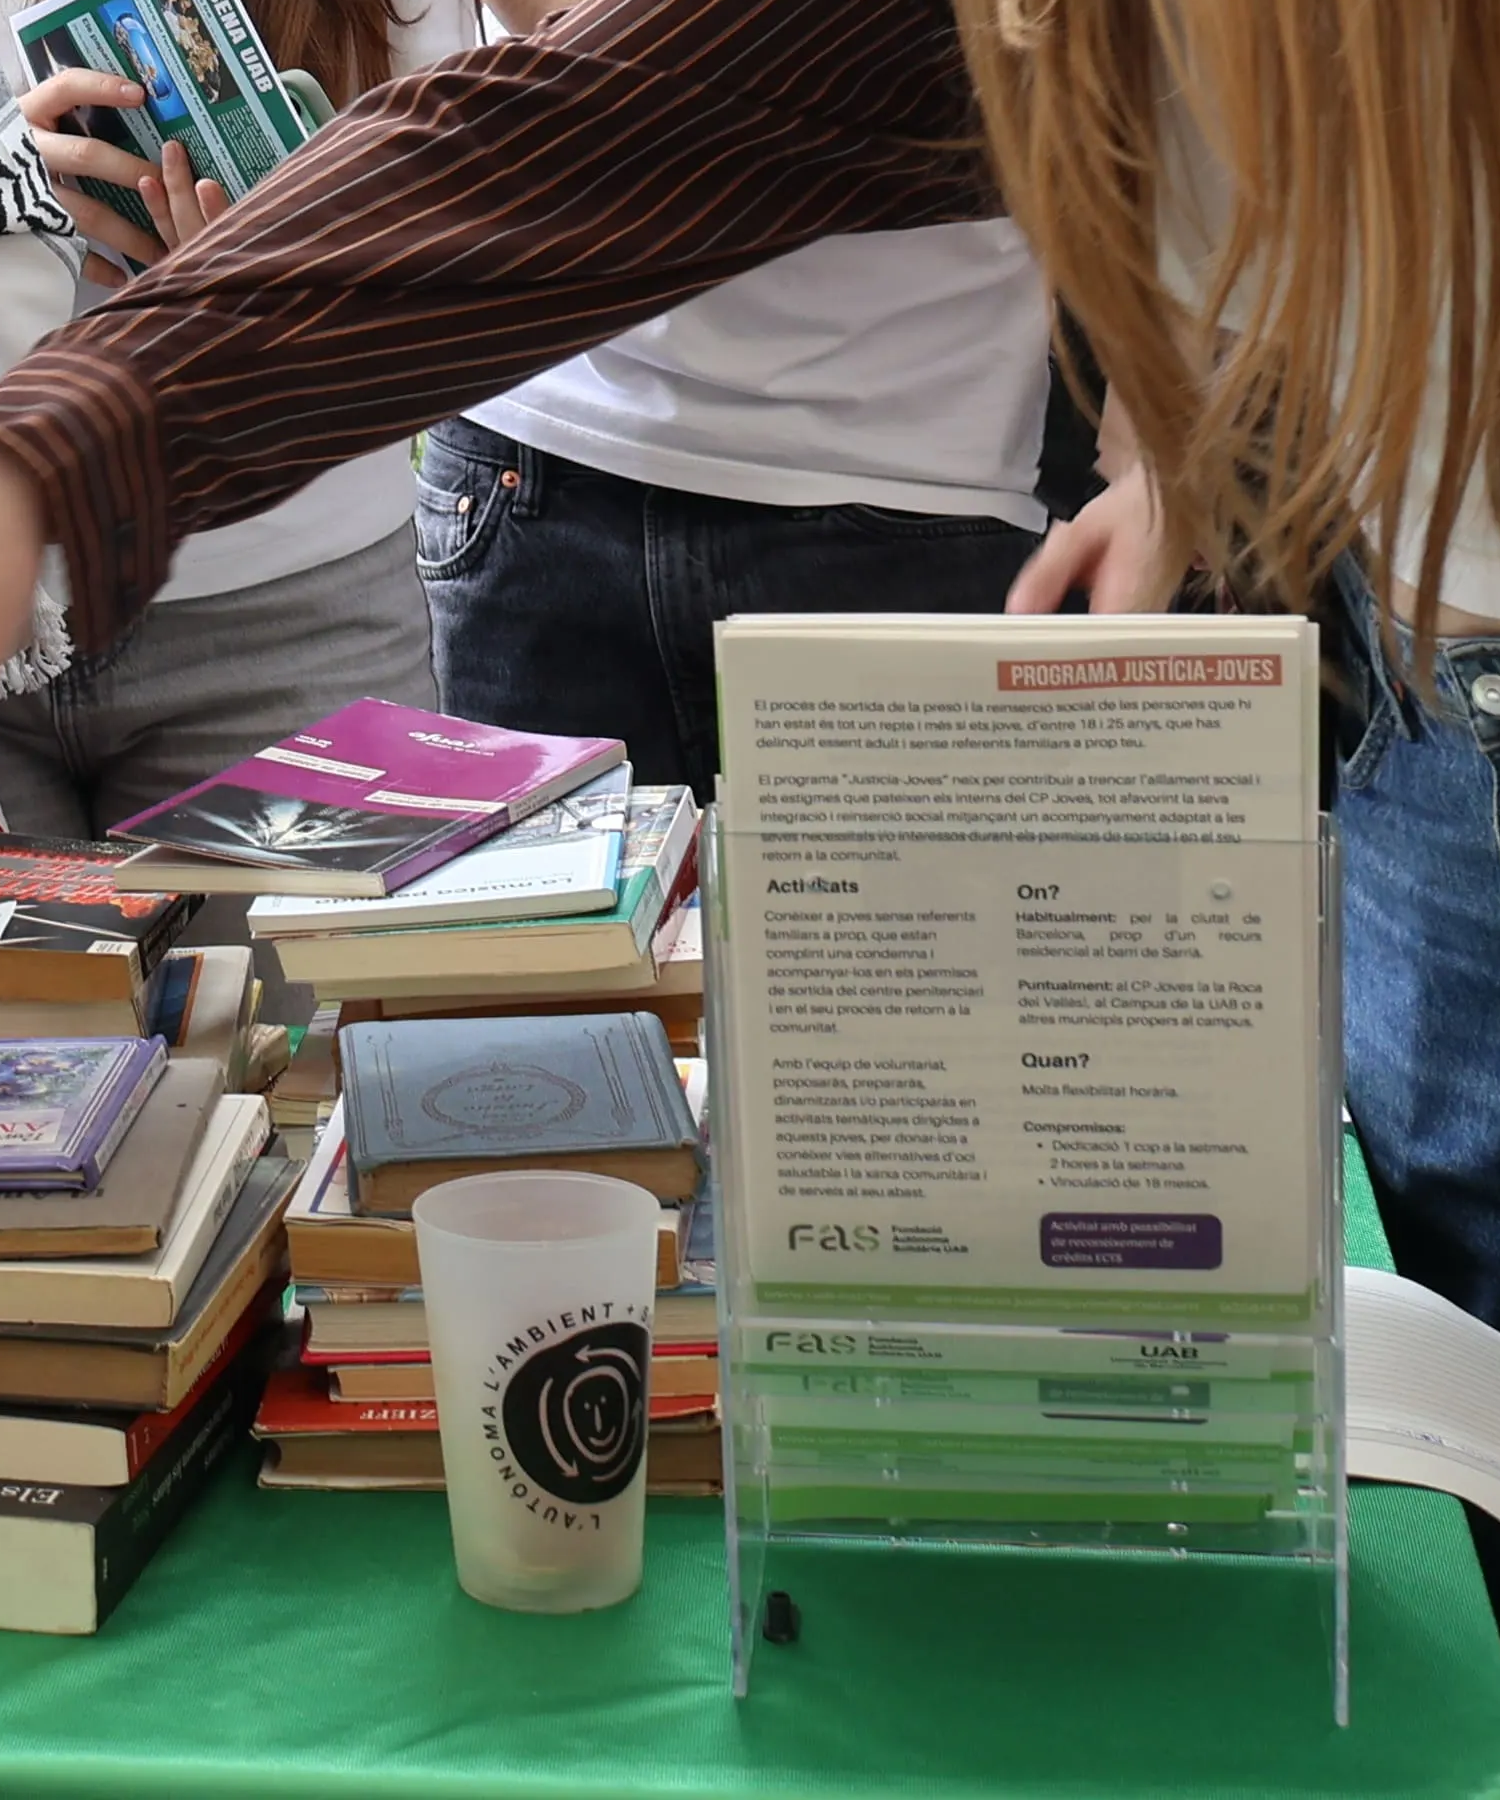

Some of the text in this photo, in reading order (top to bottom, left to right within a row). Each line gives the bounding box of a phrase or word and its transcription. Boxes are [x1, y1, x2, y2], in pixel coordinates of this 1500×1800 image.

[240, 46, 274, 93] UAB
[1011, 657, 1274, 687] PROGRAMA JUSTÍCIA-JOVES
[1016, 883, 1060, 901] On?
[1015, 911, 1116, 924] Habitualment:
[1017, 979, 1113, 992] Puntualment:
[1021, 1052, 1090, 1069] Quan?
[1022, 1120, 1126, 1135] Compromisos:
[483, 1301, 615, 1392] L'AMBIENT
[0, 1484, 64, 1506] Els
